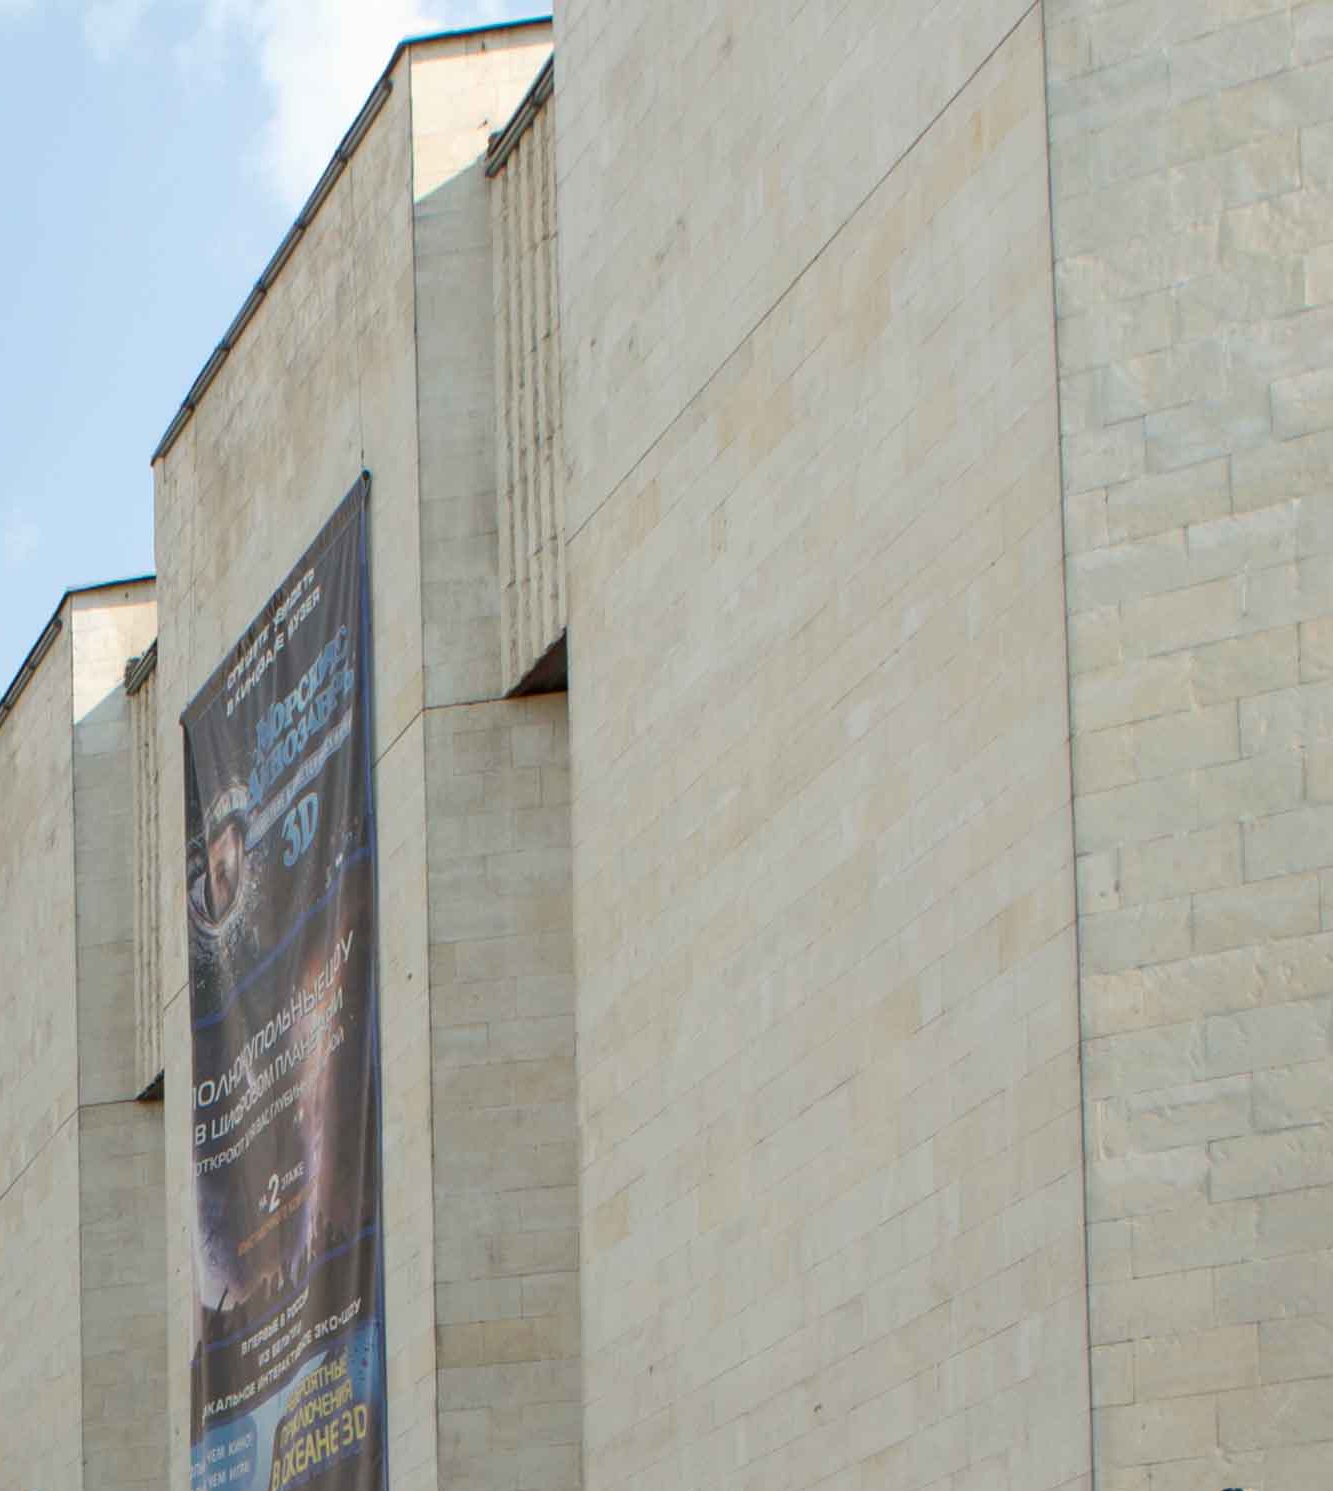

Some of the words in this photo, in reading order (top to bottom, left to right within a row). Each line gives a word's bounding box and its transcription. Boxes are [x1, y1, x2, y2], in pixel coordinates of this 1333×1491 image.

[282, 791, 319, 867] 3D
[194, 1122, 208, 1146] В
[268, 1173, 281, 1214] 2
[341, 1404, 369, 1446] 3D
